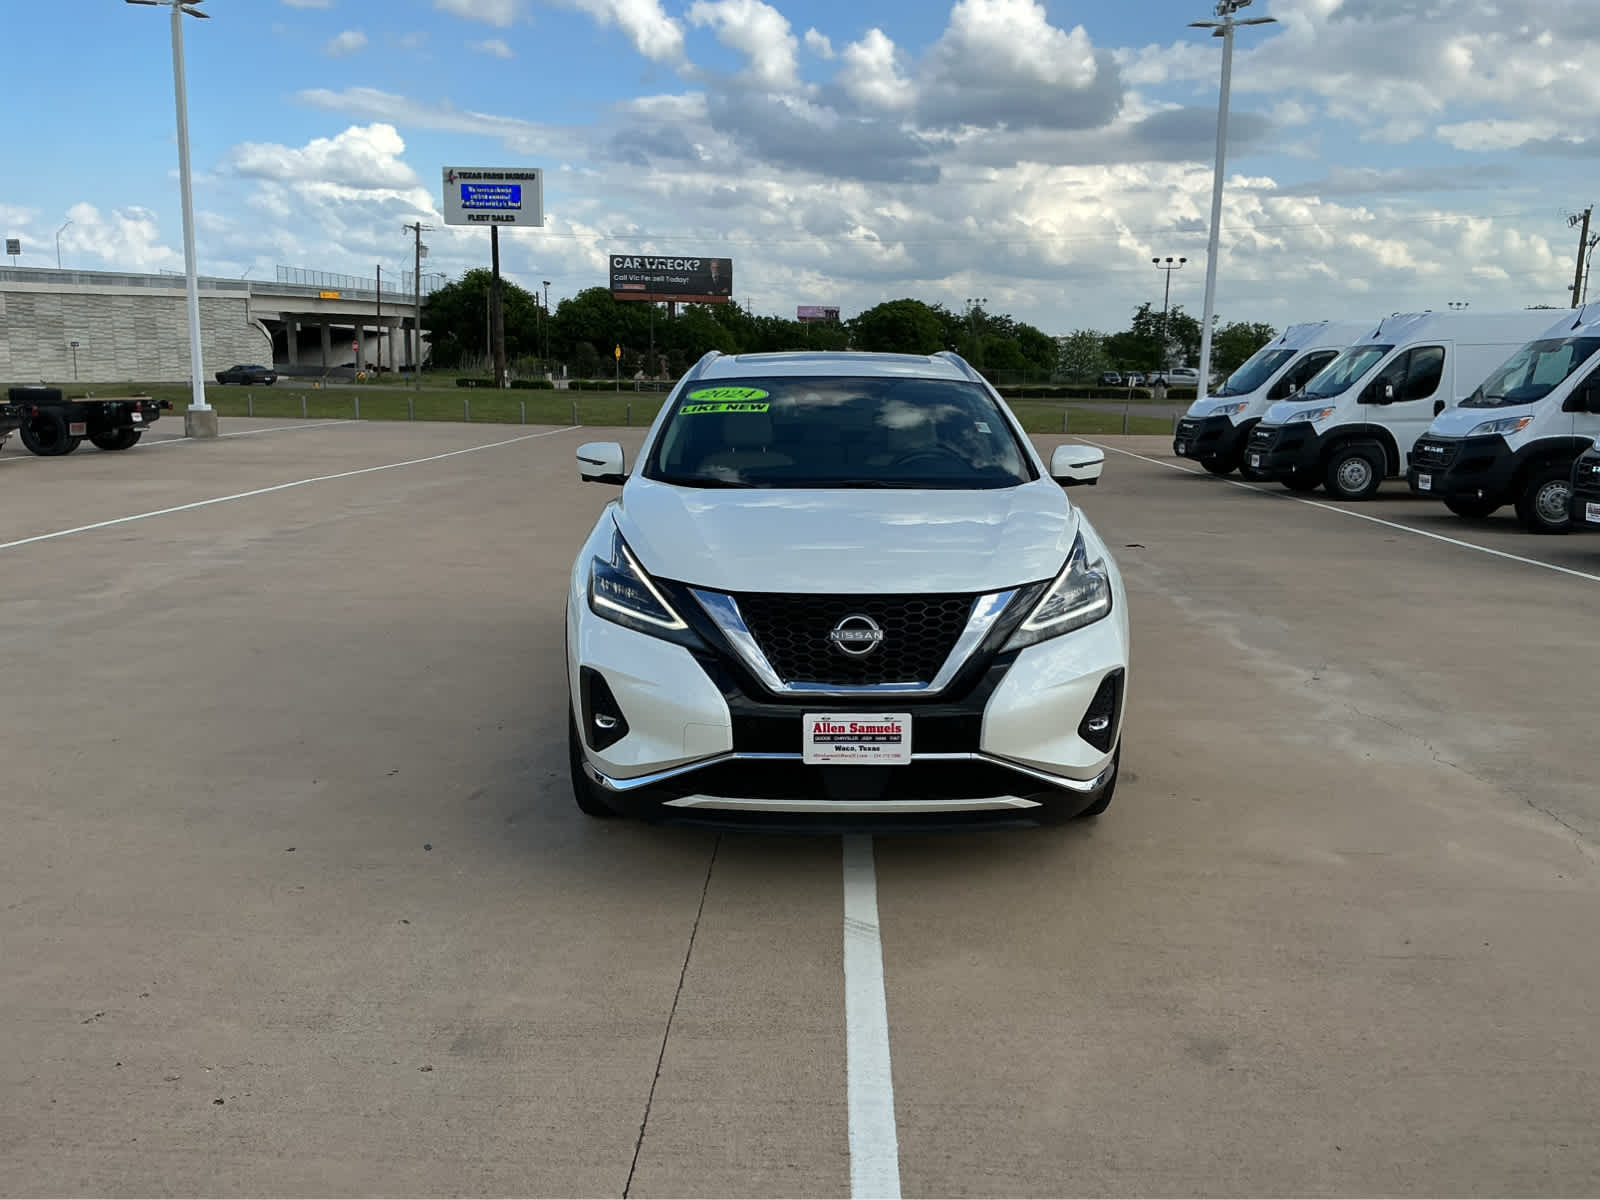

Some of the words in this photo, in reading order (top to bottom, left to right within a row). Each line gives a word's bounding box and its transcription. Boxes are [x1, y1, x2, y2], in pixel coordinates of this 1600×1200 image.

[613, 257, 641, 269] CAR
[645, 258, 700, 271] WRECK?
[681, 405, 719, 413] LIKE
[831, 631, 882, 640] NISSAN
[813, 723, 846, 733] Allen
[849, 723, 902, 733] Samuels
